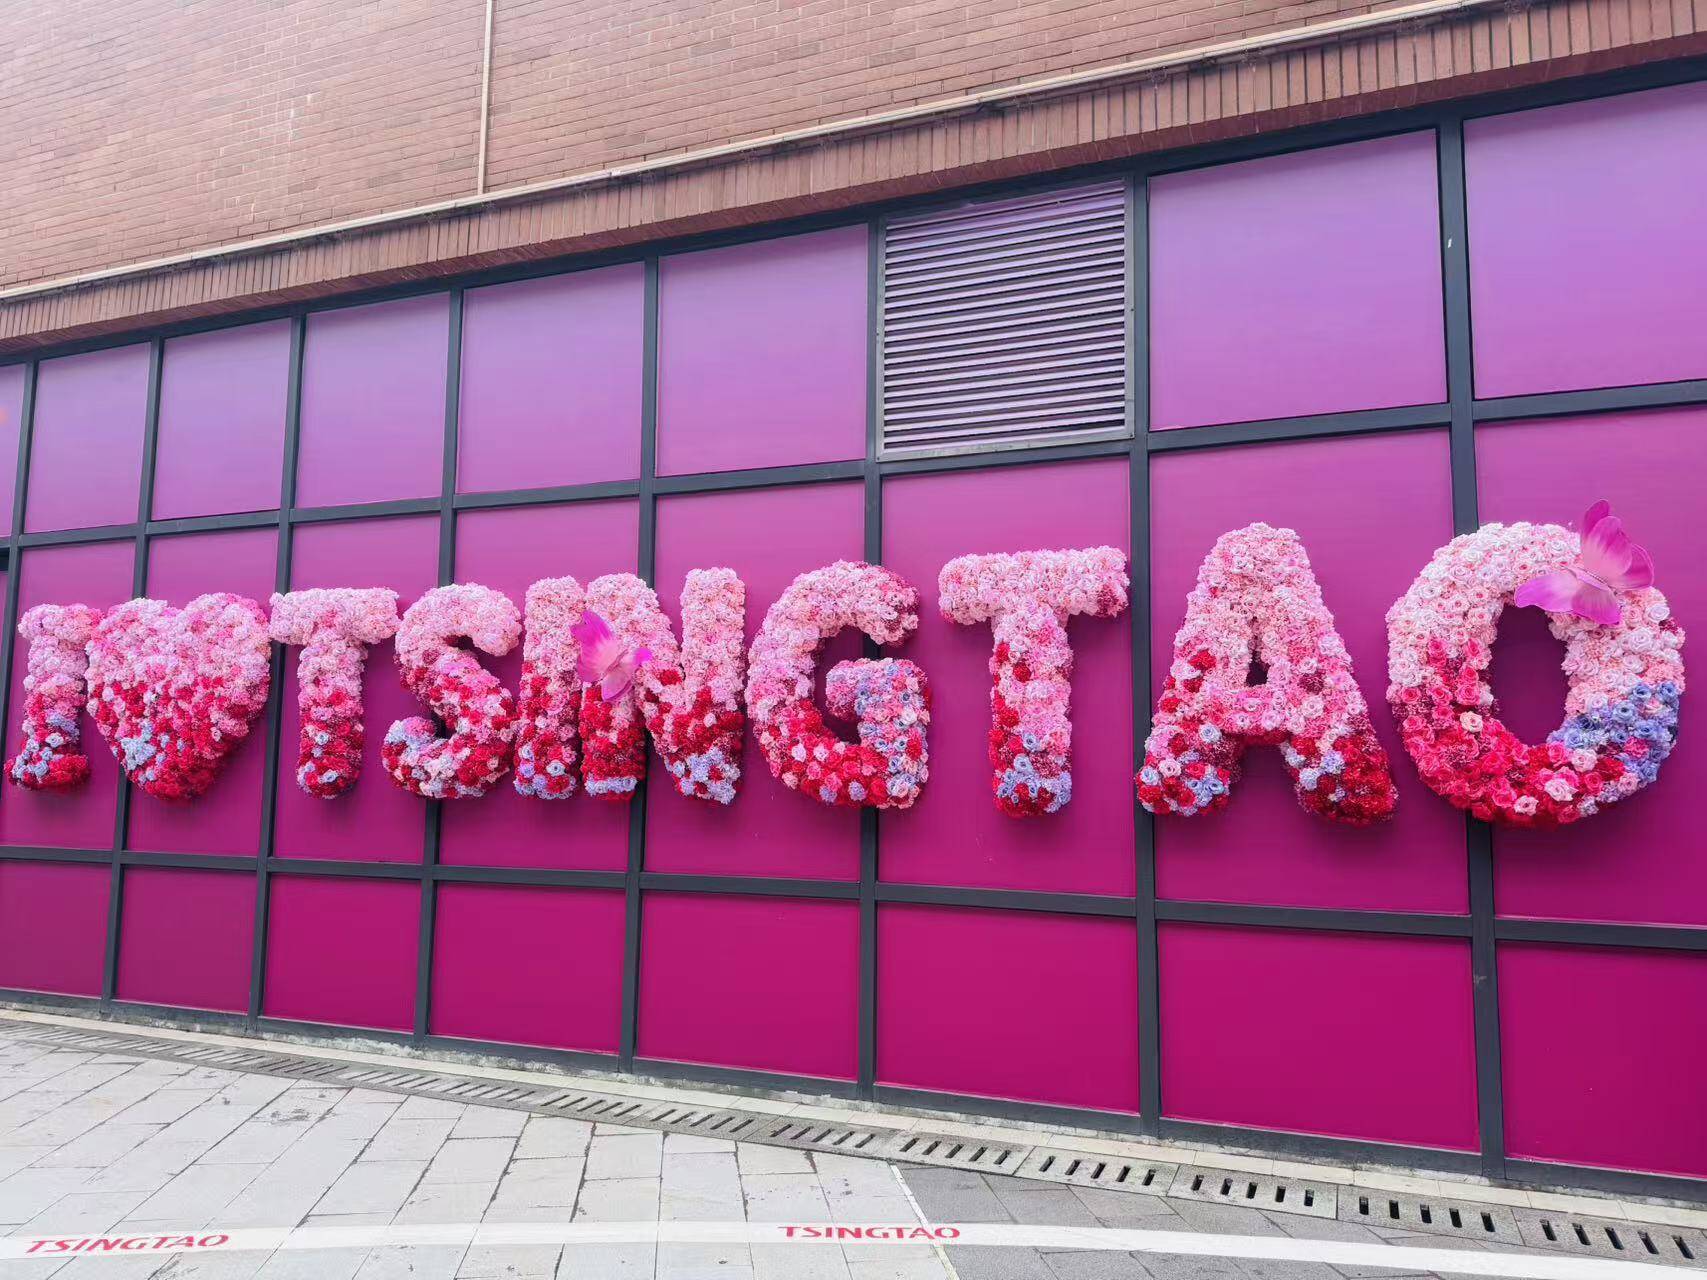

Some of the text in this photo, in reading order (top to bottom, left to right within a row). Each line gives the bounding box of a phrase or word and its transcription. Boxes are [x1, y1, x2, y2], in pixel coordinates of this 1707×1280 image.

[4, 521, 1686, 825] I TSINGTAO
[778, 1226, 961, 1239] TSINGTAO
[25, 1234, 229, 1254] TSINGTAO
